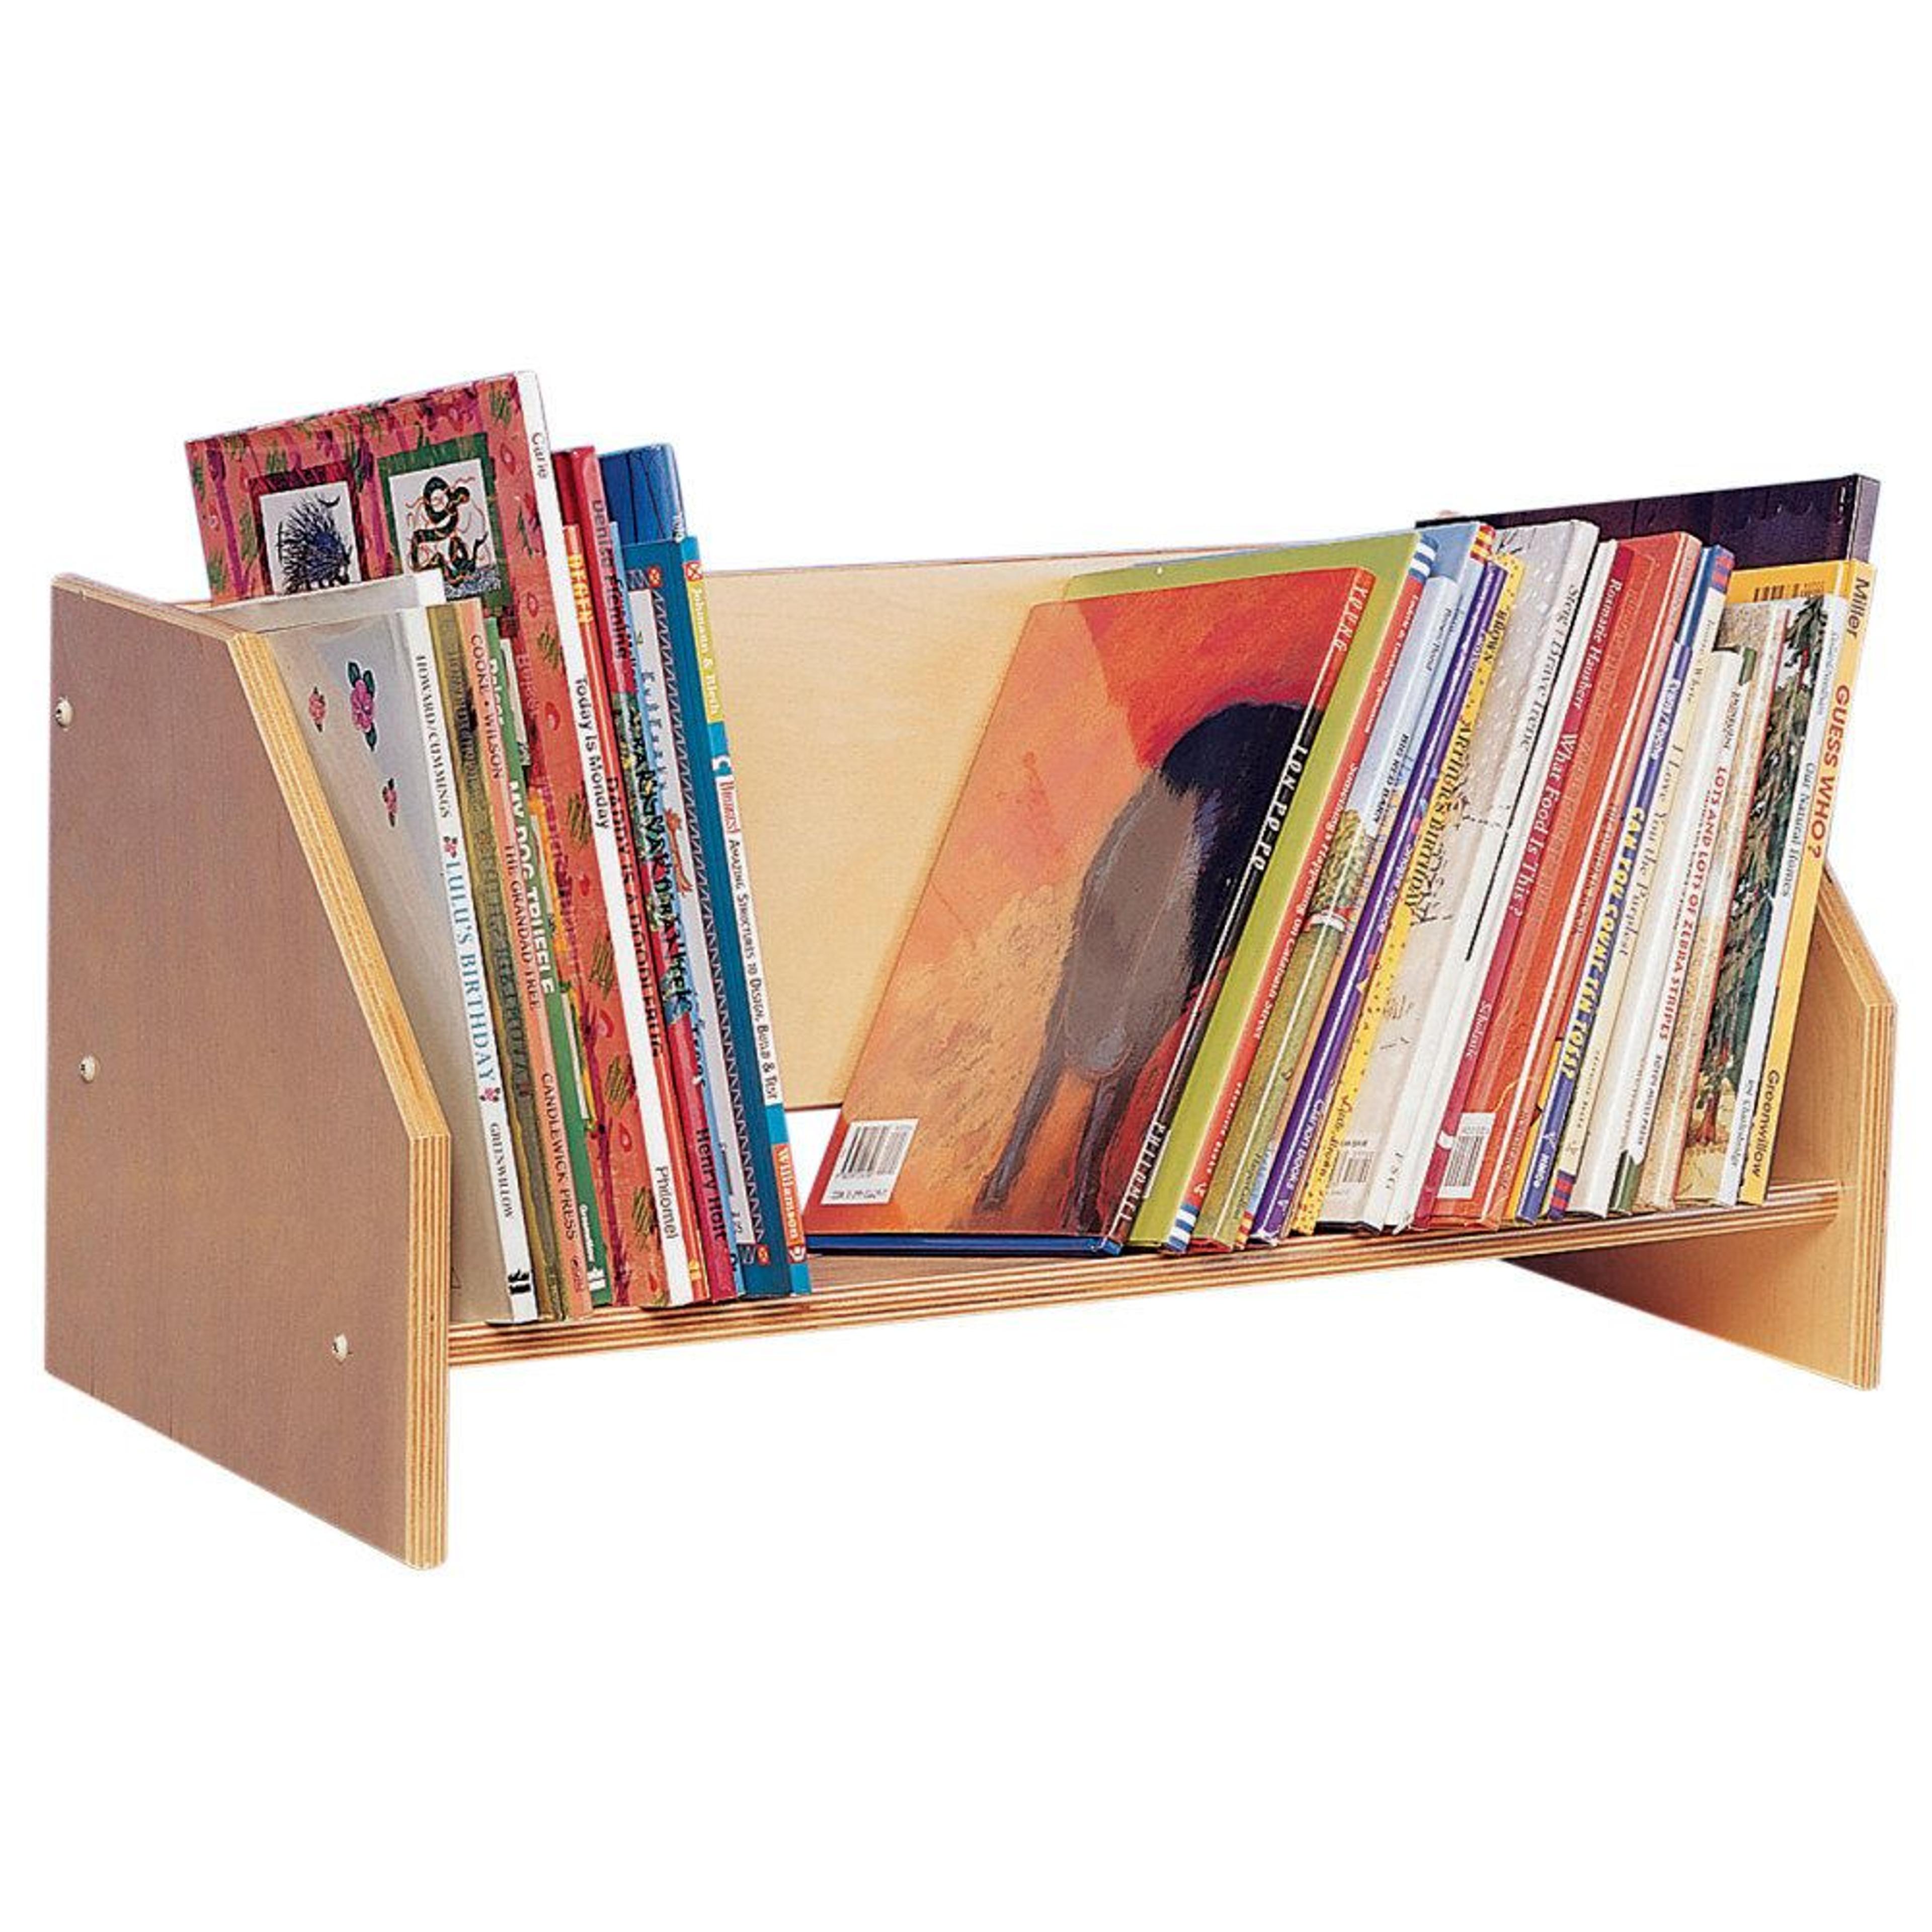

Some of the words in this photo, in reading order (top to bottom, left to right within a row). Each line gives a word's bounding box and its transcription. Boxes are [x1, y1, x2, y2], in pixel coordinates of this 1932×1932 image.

[1331, 585, 1370, 654] YOUNG
[1844, 577, 1871, 640] Miller
[470, 634, 491, 694] COOKE
[482, 713, 504, 780] WILSON
[571, 676, 595, 731] Today
[1823, 683, 1853, 768] GUESS
[416, 655, 454, 818] HOWARD/CUMMINGS
[584, 735, 598, 752] Is
[1548, 730, 1578, 783] What
[583, 755, 612, 831] Monday
[1708, 766, 1727, 807] LOTS
[1801, 762, 1816, 788] Our
[605, 776, 631, 856] DADDY
[1533, 785, 1561, 834] Food
[1623, 806, 1647, 850] CAN
[1700, 809, 1718, 848] AND
[1790, 794, 1810, 845] Natural
[1806, 774, 1836, 859] WHO?
[504, 843, 519, 875] THE
[620, 862, 635, 884] IS
[1401, 816, 1444, 911] BIRTHDAY
[1526, 837, 1545, 855] Is
[1690, 851, 1709, 891] LOTS
[1781, 848, 1800, 898] Homes
[445, 860, 475, 945] LULU'S
[625, 892, 638, 905] A
[1511, 859, 1539, 902] This
[1608, 856, 1633, 900] YOU
[1685, 893, 1700, 915] OF
[510, 879, 534, 964] GRANDAD
[1588, 902, 1620, 973] COUNT
[1671, 919, 1694, 975] ZEBRA
[459, 952, 496, 1082] BIRTHDAY
[524, 969, 541, 1011] TREE
[1577, 976, 1600, 1015] TEN
[1658, 976, 1681, 1041] STRIPES
[1464, 999, 1493, 1062] Scholastic
[1749, 1069, 1782, 1179] Greenwillow
[489, 1121, 514, 1220] GREENWILLOW
[540, 1072, 569, 1183] CANDLEWICK
[558, 1187, 579, 1241] PRESS
[693, 1126, 719, 1191] Henry
[707, 1194, 728, 1243] Holt
[1117, 1120, 1167, 1222] PHILOMEL
[651, 1164, 684, 1241] Philomel
[775, 1146, 803, 1240] Williamson
